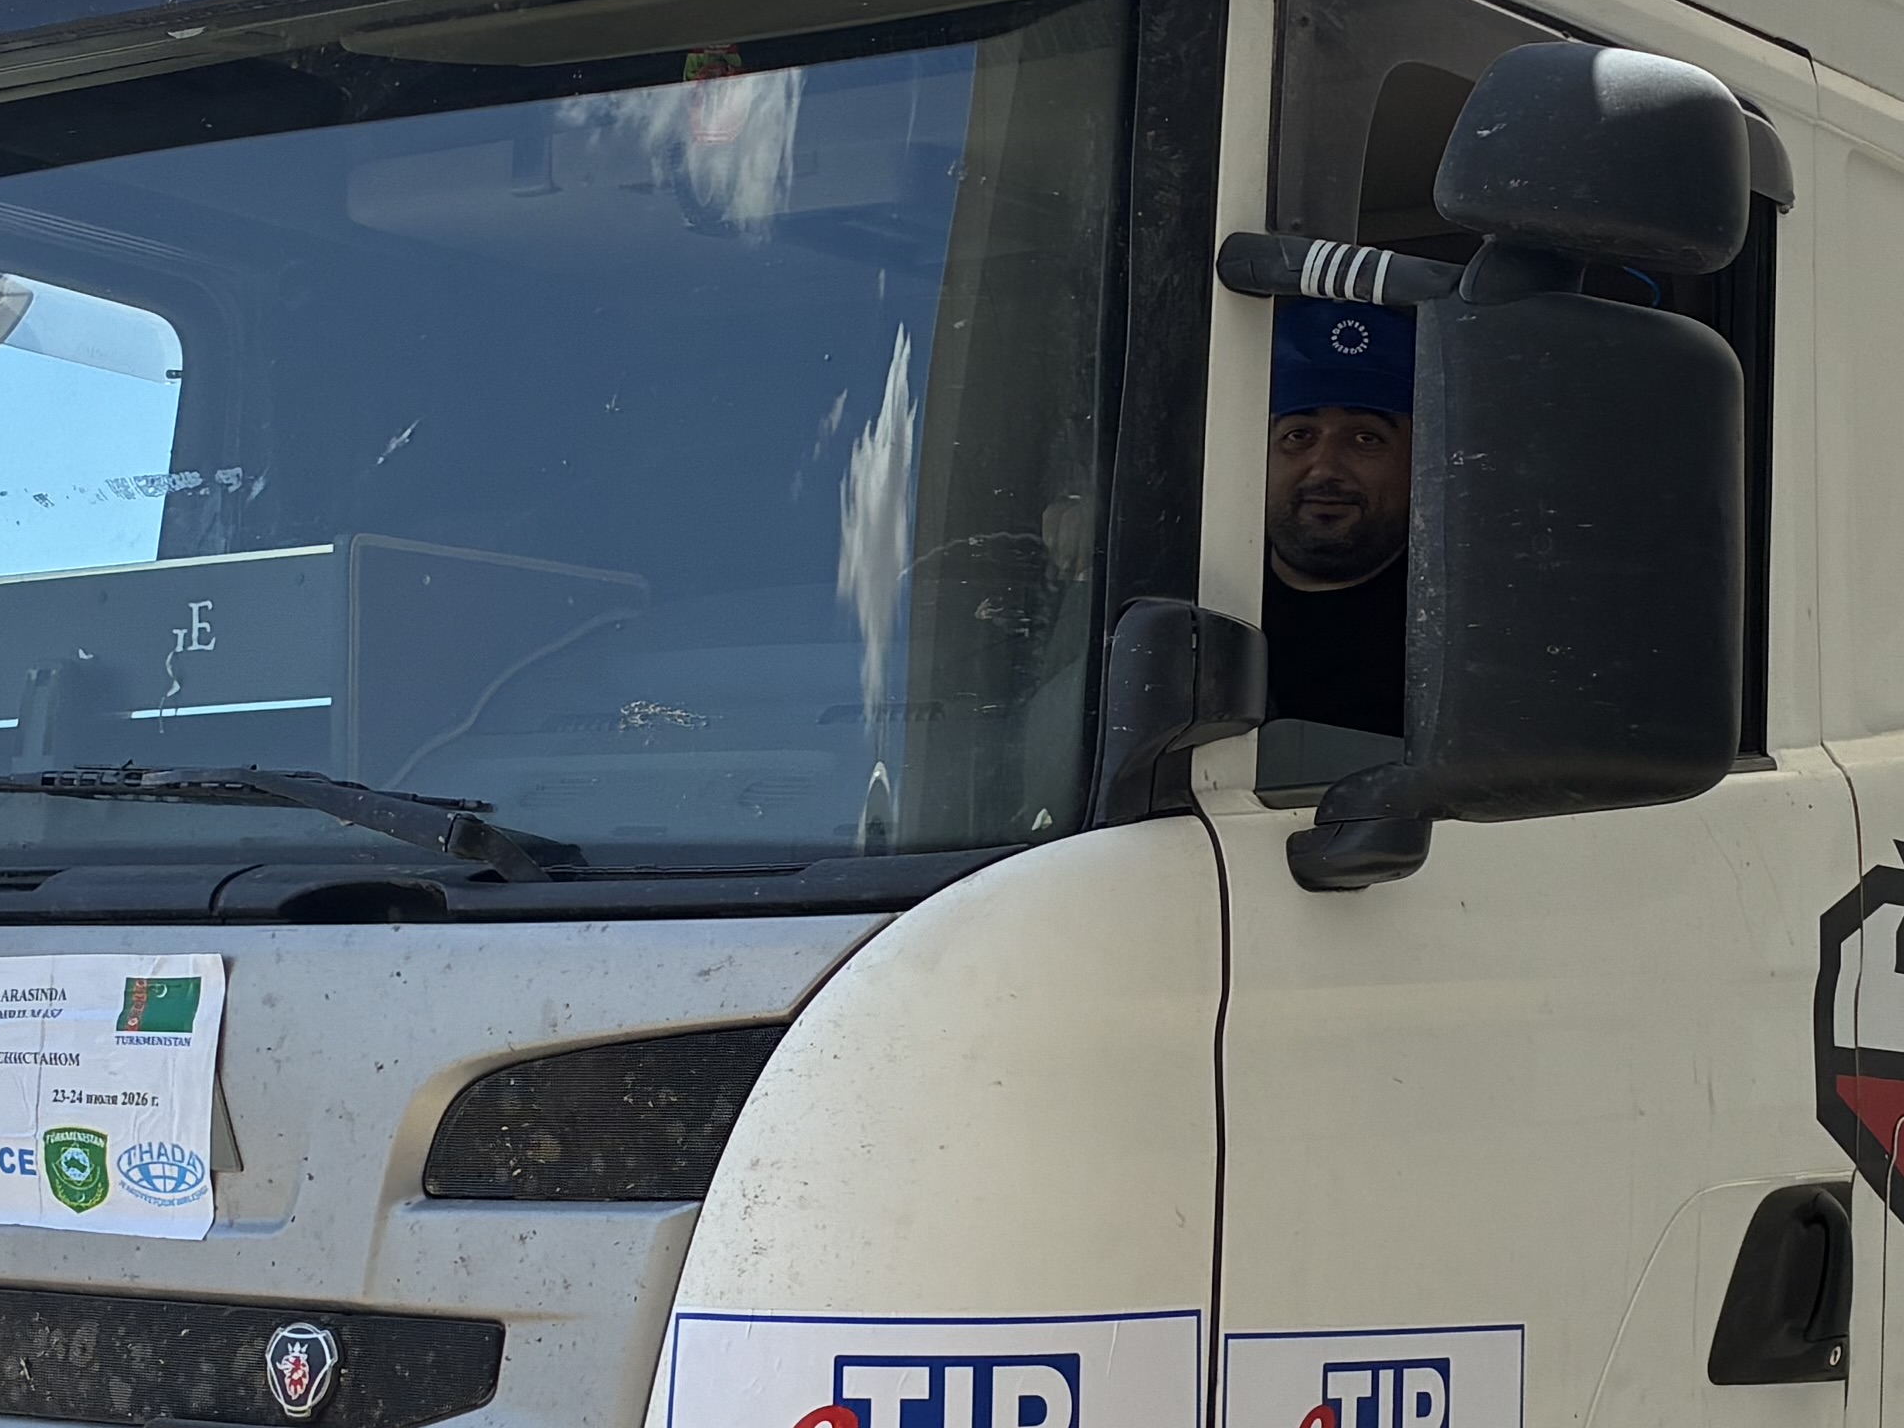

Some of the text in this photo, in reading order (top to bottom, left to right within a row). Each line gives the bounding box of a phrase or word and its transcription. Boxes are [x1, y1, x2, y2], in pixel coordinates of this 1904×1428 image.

[52, 1089, 83, 1104] 23-24
[121, 1092, 149, 1106] 2026
[123, 1141, 199, 1173] THADA
